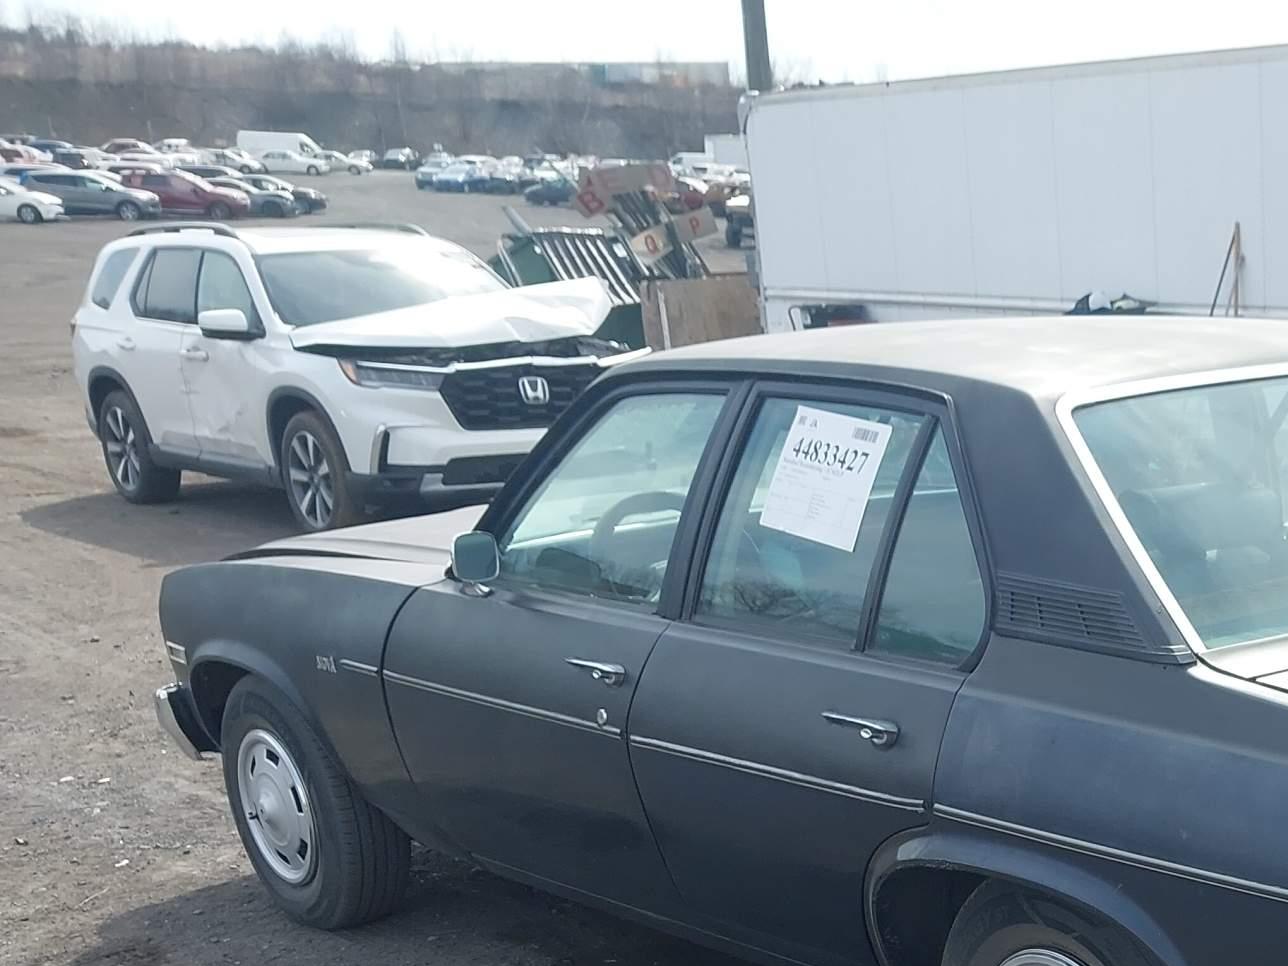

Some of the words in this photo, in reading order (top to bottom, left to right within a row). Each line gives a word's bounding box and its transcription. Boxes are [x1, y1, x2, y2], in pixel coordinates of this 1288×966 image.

[576, 191, 606, 215] B
[689, 215, 701, 236] P
[792, 437, 870, 475] 44833427
